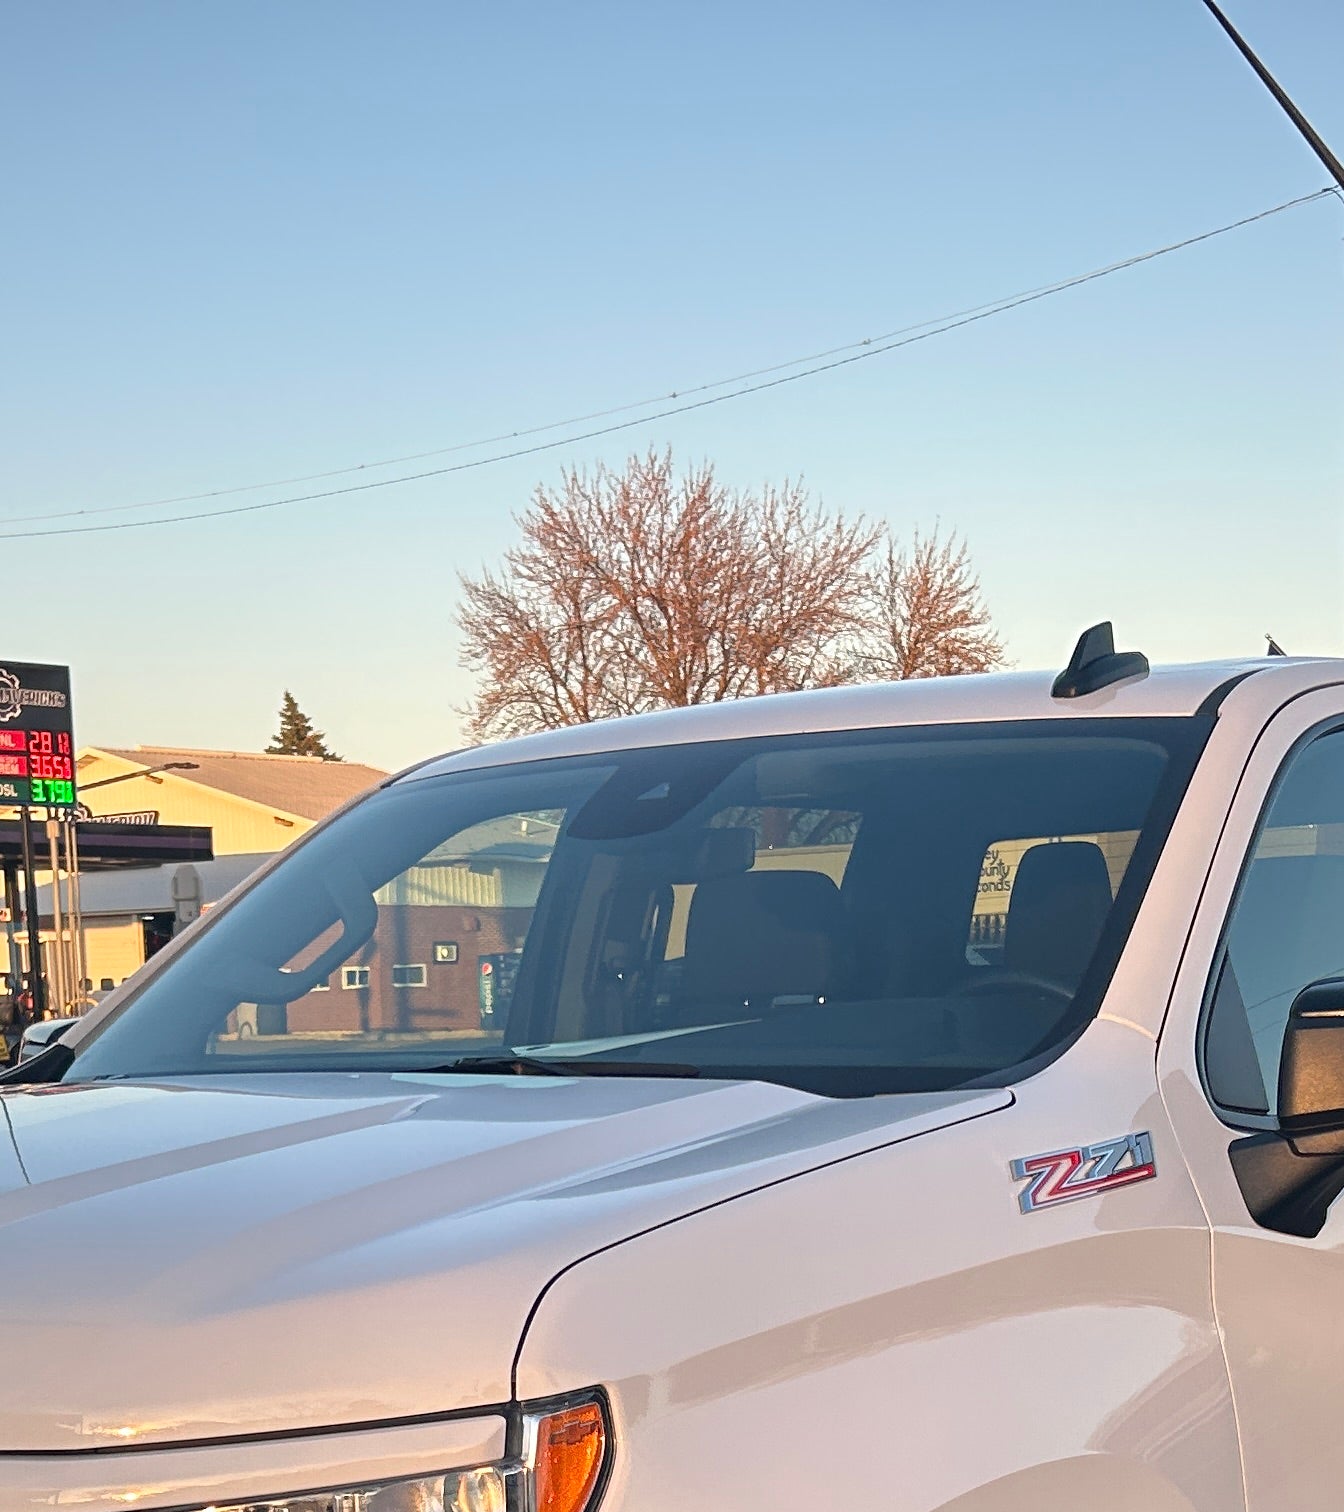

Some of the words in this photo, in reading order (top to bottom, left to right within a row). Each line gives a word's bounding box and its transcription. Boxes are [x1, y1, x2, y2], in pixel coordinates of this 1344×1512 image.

[981, 859, 1011, 880] ounty
[977, 880, 1011, 893] conds
[1009, 1130, 1158, 1216] Z71
